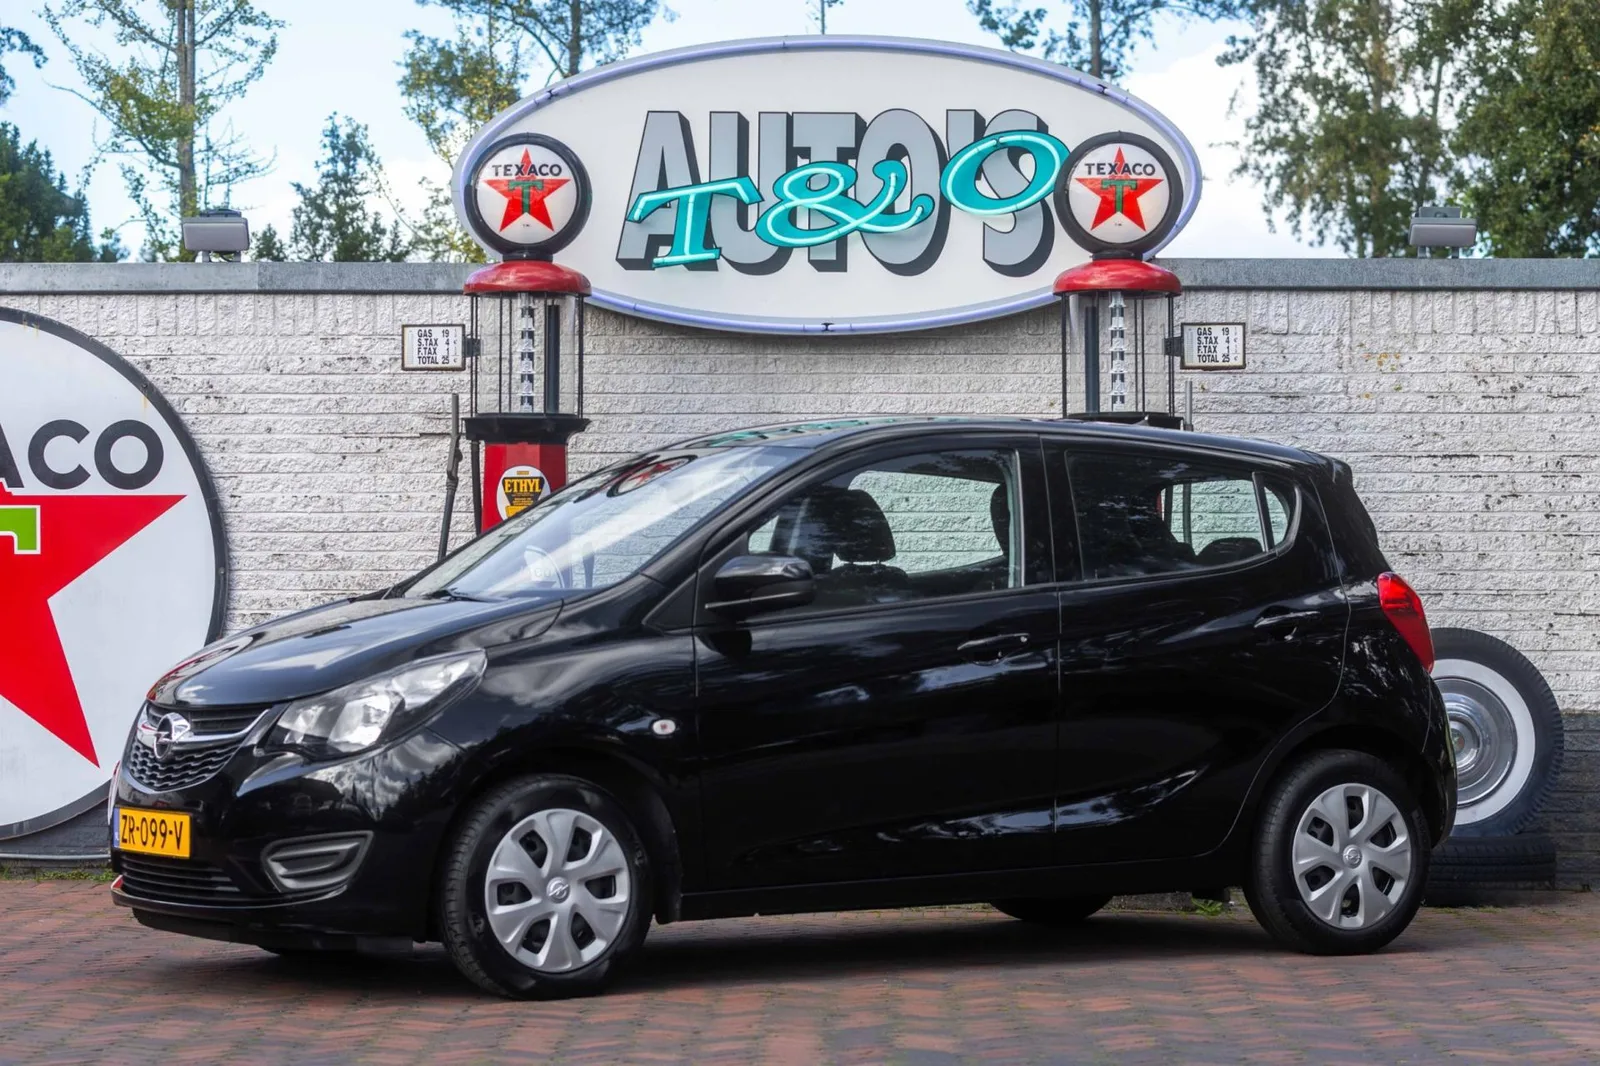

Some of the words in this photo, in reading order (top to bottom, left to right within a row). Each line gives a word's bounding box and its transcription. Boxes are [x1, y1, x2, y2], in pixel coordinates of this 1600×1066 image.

[492, 164, 562, 177] TEXACO
[1084, 163, 1156, 176] TEXACO
[616, 108, 1054, 276] AUTO'S
[626, 176, 764, 268] T
[755, 160, 935, 247] &
[417, 329, 433, 338] GAS
[441, 329, 449, 338] 19
[1197, 327, 1212, 336] GAS
[1222, 327, 1229, 336] 19
[417, 338, 438, 347] S.TAX
[445, 338, 449, 346] 4
[1197, 336, 1218, 345] S.TAX
[1225, 336, 1230, 345] 4
[417, 347, 437, 356] F.TAX
[1197, 345, 1217, 354] F.TAX
[417, 356, 439, 365] TOTAL
[441, 356, 450, 365] 25
[1197, 354, 1219, 363] TOTAL
[1222, 354, 1230, 363] 25
[504, 478, 542, 493] ETHYL
[121, 814, 183, 850] ZR-099-V
